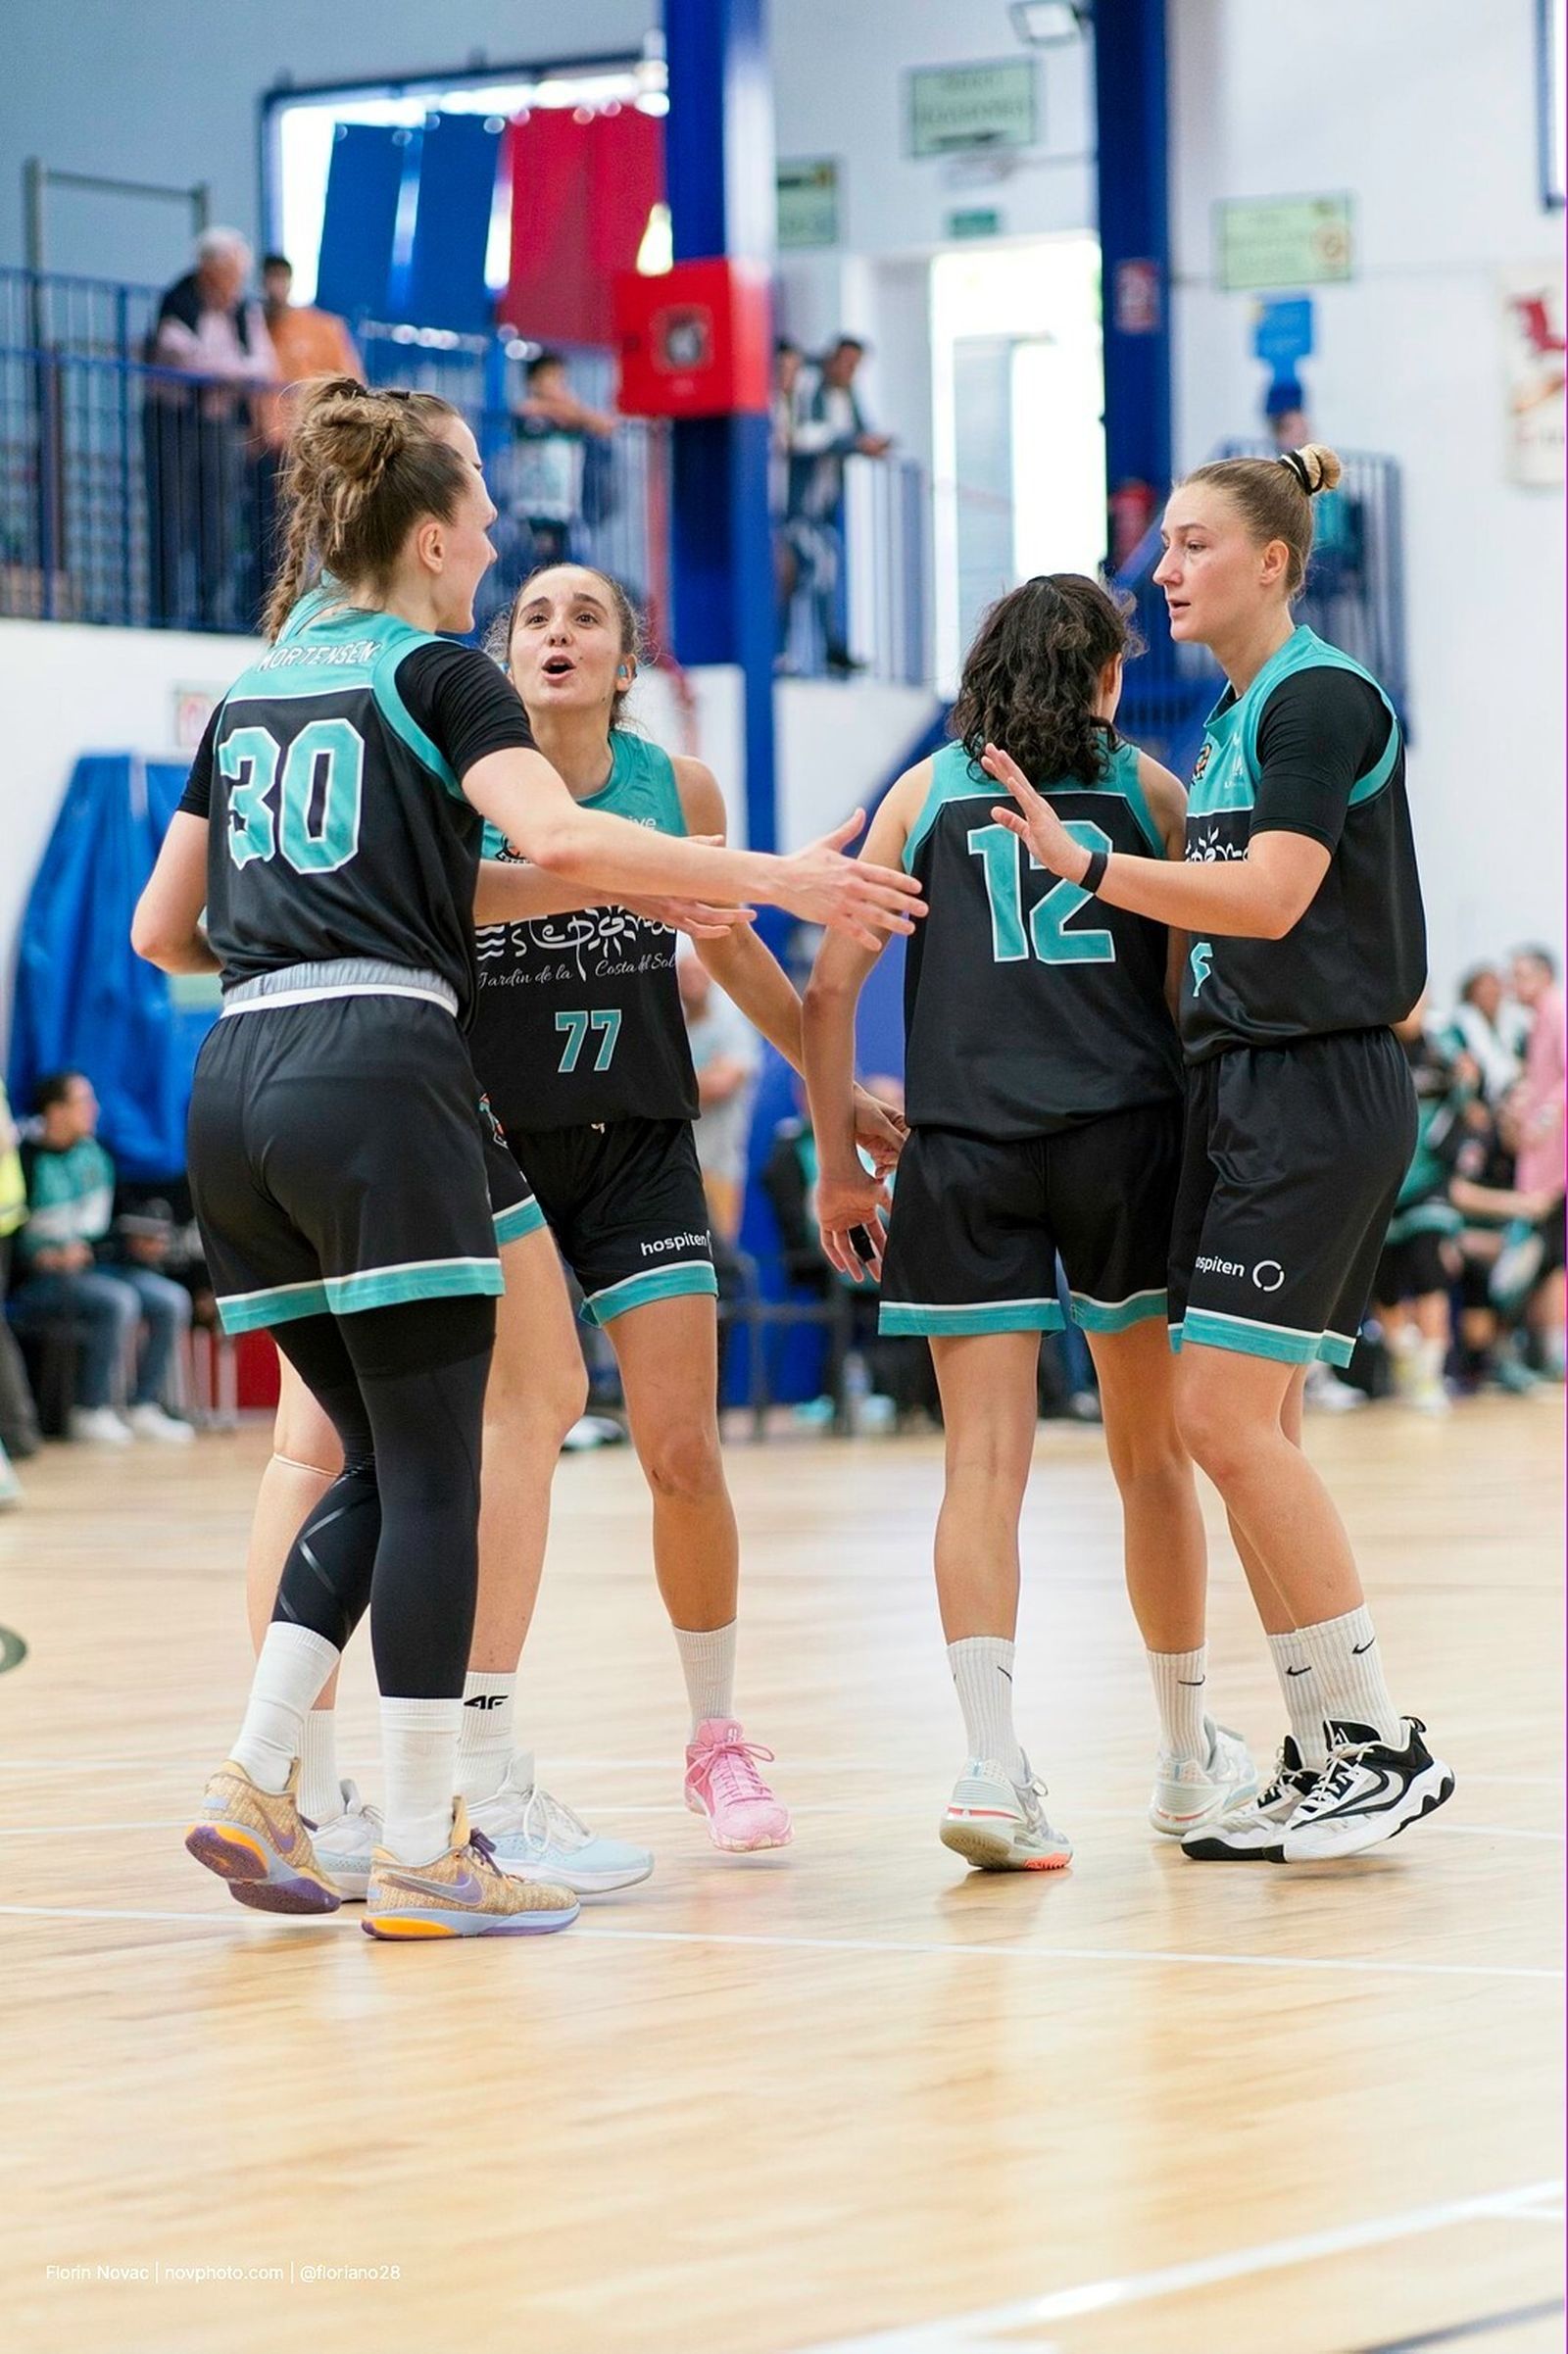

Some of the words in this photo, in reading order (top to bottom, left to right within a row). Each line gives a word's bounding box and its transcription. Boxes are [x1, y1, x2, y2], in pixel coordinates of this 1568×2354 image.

[219, 717, 366, 875] 30
[967, 820, 1116, 964] 12
[534, 964, 553, 983] de
[555, 963, 573, 980] la
[595, 959, 637, 977] Costa
[651, 953, 676, 969] Sol
[555, 1008, 622, 1073] 77
[640, 1232, 708, 1257] hospiten
[464, 1695, 509, 1710] 4F
